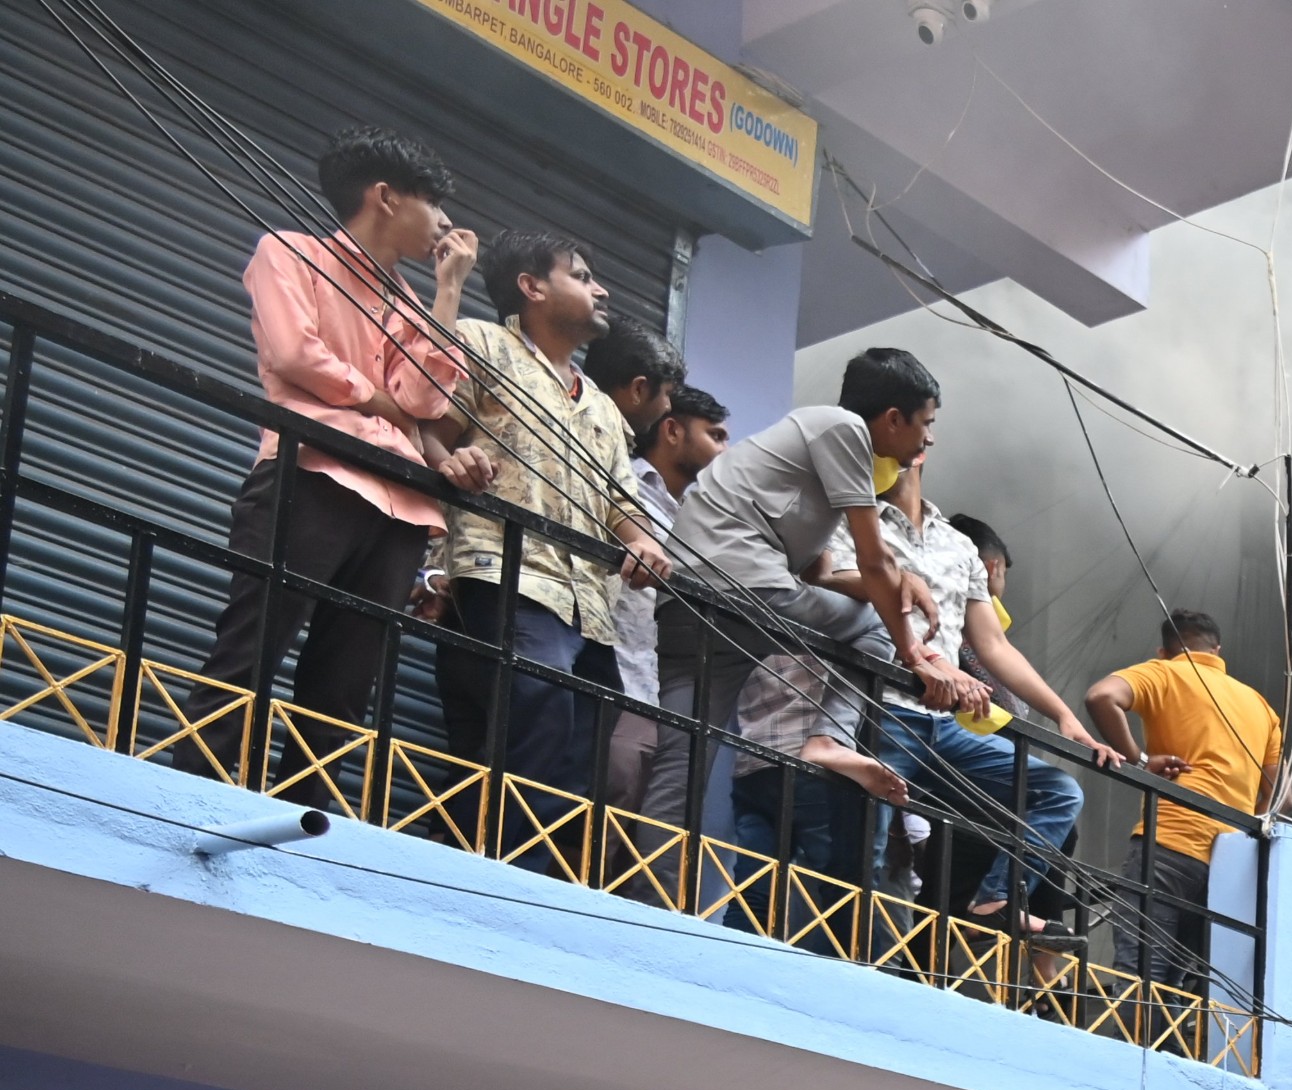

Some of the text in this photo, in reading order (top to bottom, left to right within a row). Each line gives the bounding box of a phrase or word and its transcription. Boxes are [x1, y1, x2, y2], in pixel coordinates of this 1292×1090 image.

[509, 28, 583, 83] BANGALORE
[594, 78, 611, 99] 560
[615, 92, 636, 114] 002.
[640, 101, 668, 130] MOBILE:
[610, 21, 799, 168] STORES (GODOWN)
